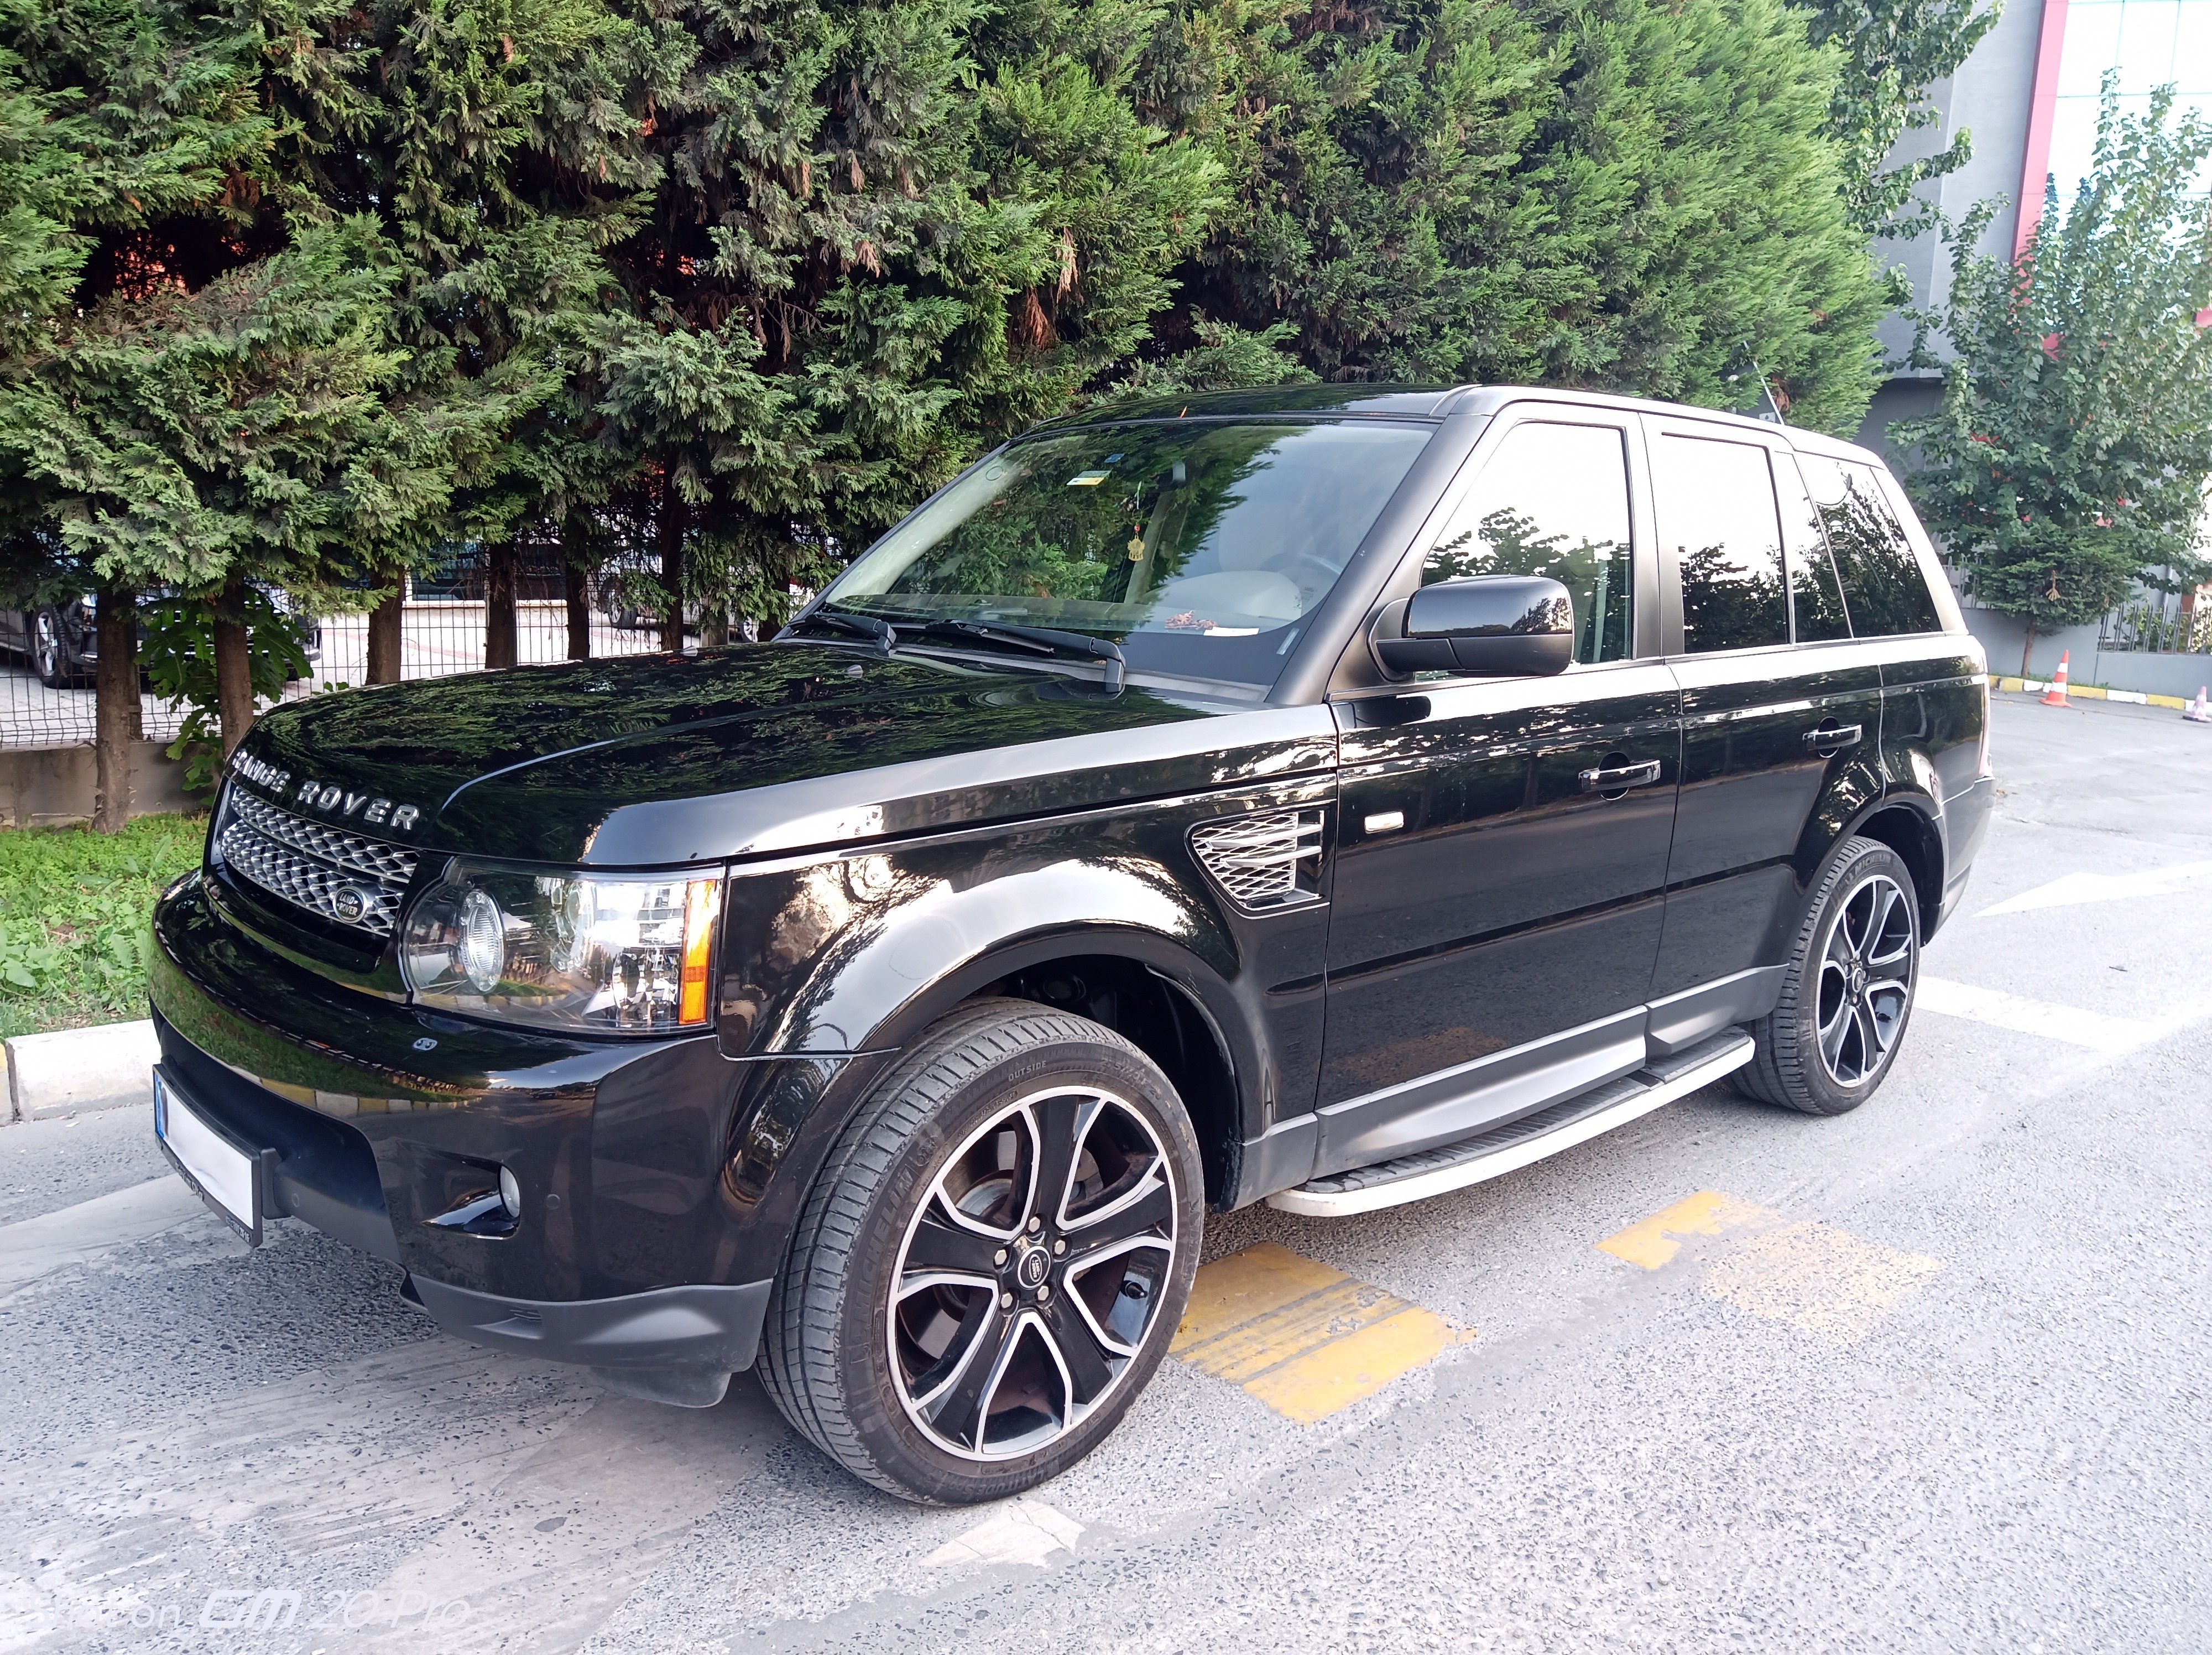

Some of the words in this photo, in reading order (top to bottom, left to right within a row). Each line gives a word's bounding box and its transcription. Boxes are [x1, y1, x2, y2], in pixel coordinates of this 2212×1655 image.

[232, 748, 290, 793] RANGE
[297, 780, 420, 830] ROVER
[338, 902, 358, 916] ROVER
[339, 893, 355, 904] LAND
[1008, 1060, 1047, 1082] OUTSIDE
[853, 1167, 914, 1324] MICHELIN
